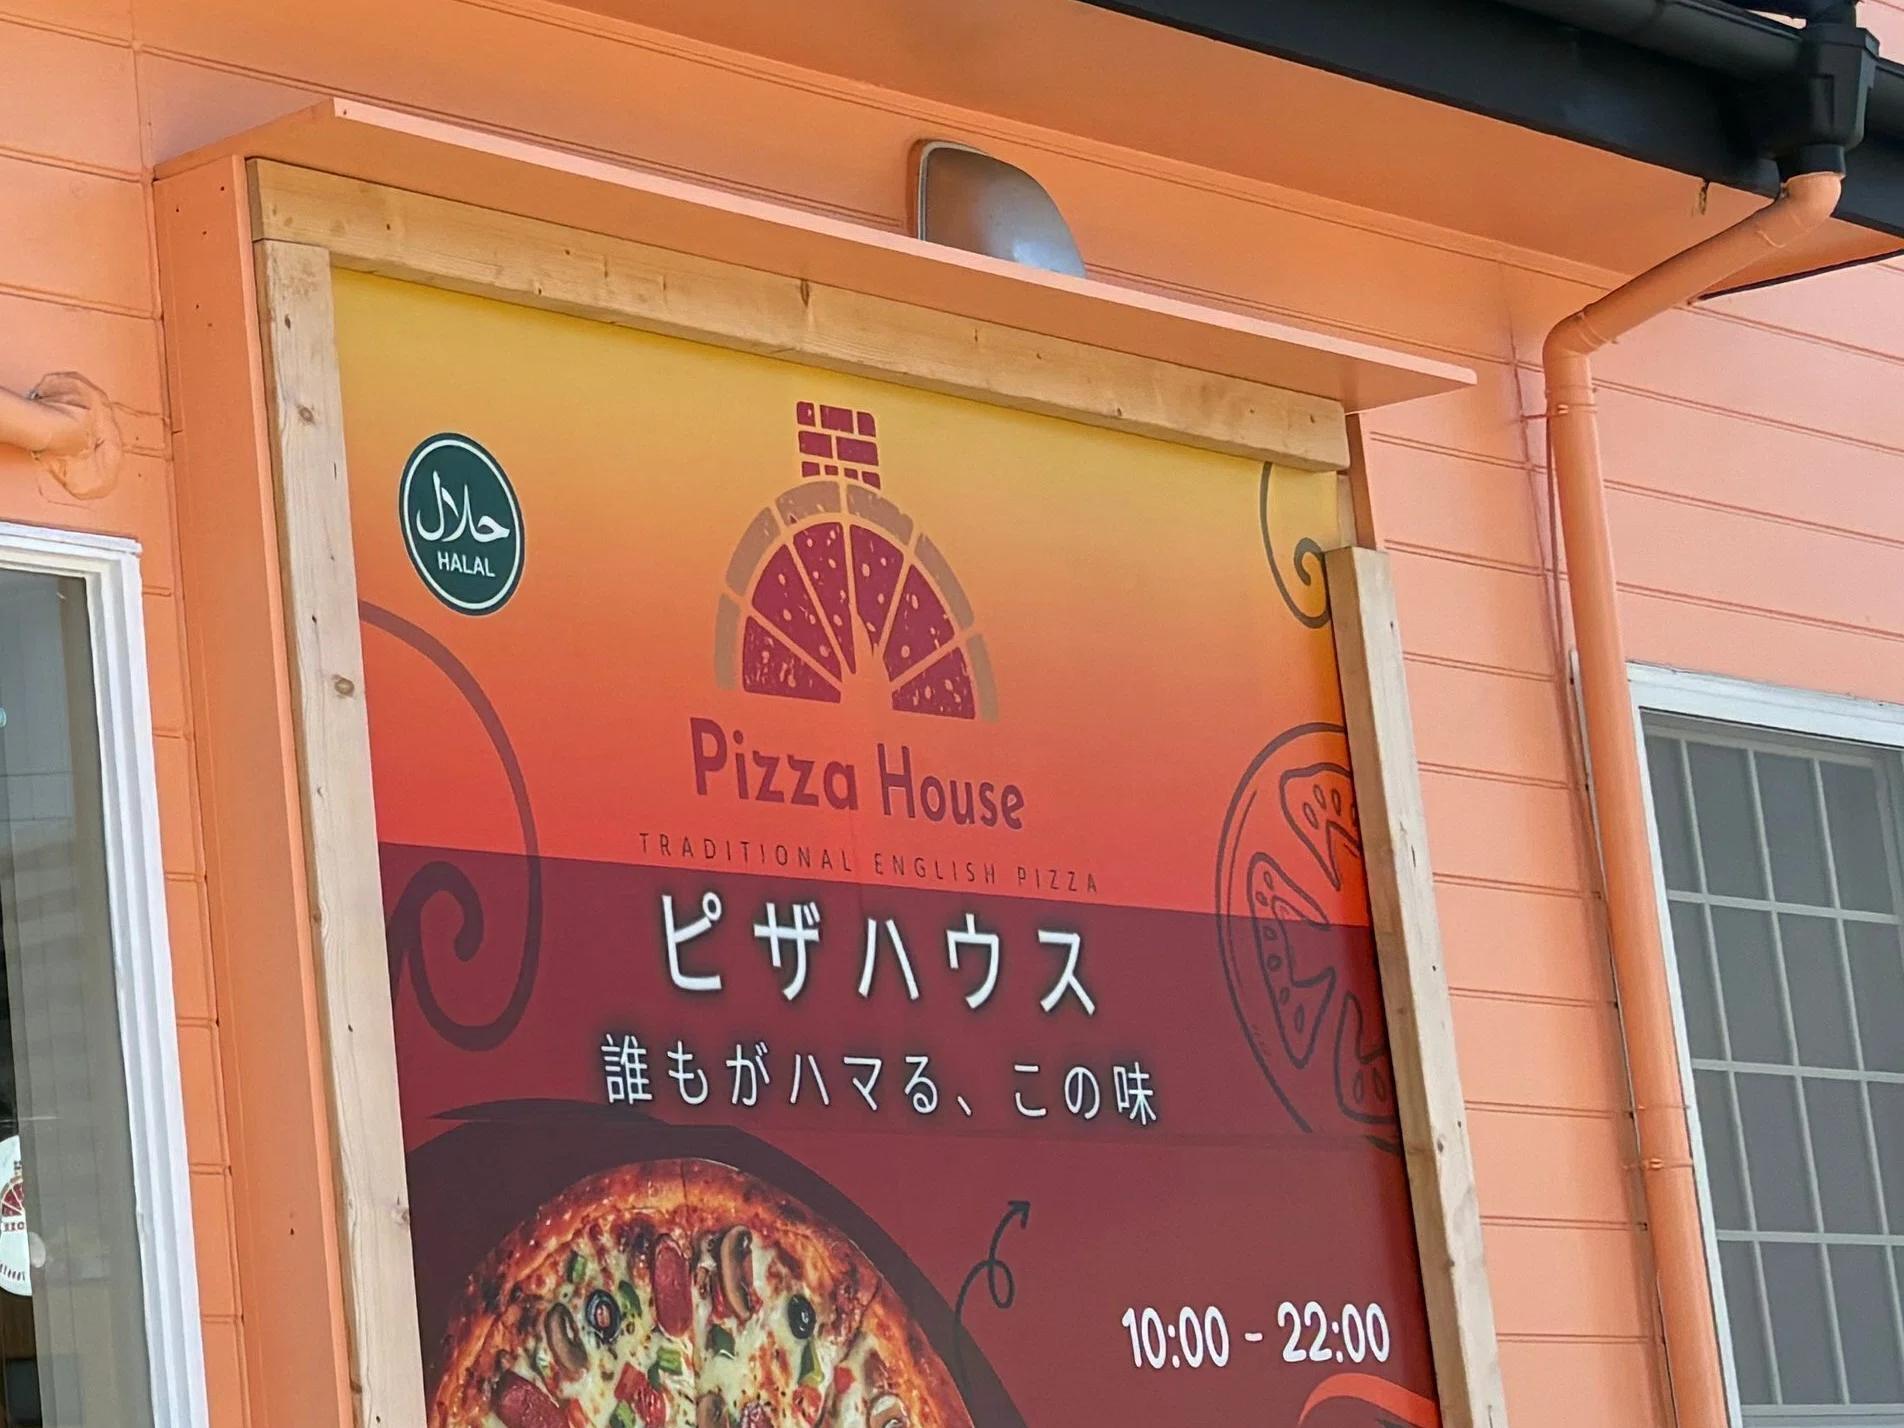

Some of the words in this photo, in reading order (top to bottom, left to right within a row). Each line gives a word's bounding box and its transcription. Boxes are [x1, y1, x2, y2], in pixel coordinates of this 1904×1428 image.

[416, 470, 511, 543] حلال
[437, 551, 496, 578] HALAL
[690, 717, 859, 811] Pizza
[877, 743, 1025, 830] House
[639, 832, 853, 873] TRADITIONAL
[875, 853, 996, 885] ENGLISH
[1018, 866, 1098, 894] PIZZA
[662, 891, 1096, 1015] ピザハウス
[1121, 1305, 1230, 1369] 10:00
[1277, 1301, 1390, 1363] 22:00
